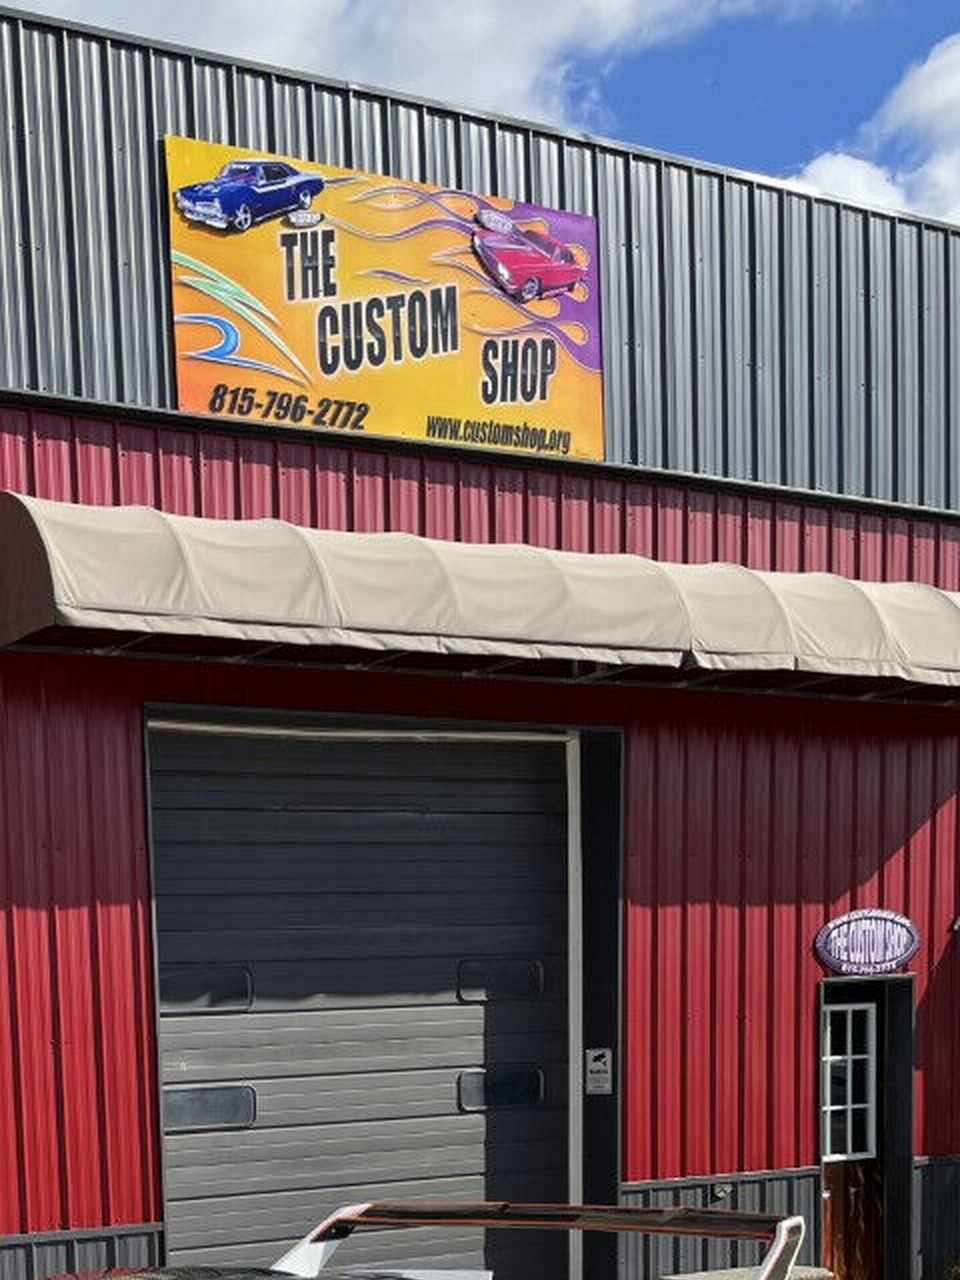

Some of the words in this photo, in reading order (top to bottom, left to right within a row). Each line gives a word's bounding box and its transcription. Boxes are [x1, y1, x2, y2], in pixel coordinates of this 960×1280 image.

[281, 228, 337, 300] THE
[318, 285, 459, 375] CUSTOM
[481, 339, 556, 404] SHOP
[209, 384, 370, 430] 815-796-2772
[426, 415, 572, 455] www.customshop.org
[830, 925, 848, 962] THE
